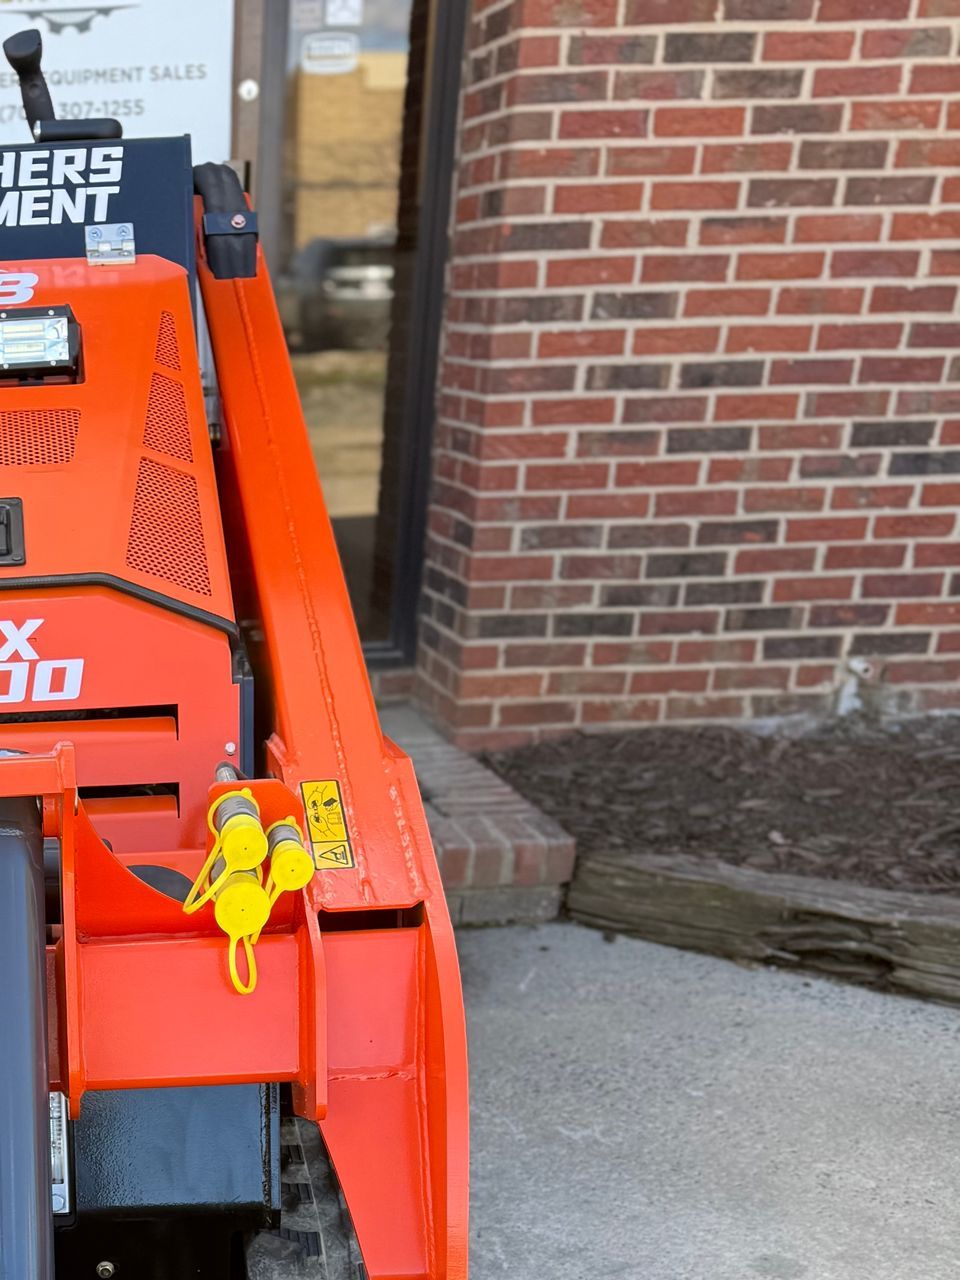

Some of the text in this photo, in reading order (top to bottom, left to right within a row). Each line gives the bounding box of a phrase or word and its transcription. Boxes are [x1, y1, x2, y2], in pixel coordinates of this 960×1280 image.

[45, 66, 144, 87] QUIPMENT
[149, 63, 207, 82] SALES
[58, 98, 145, 120] 307-1255
